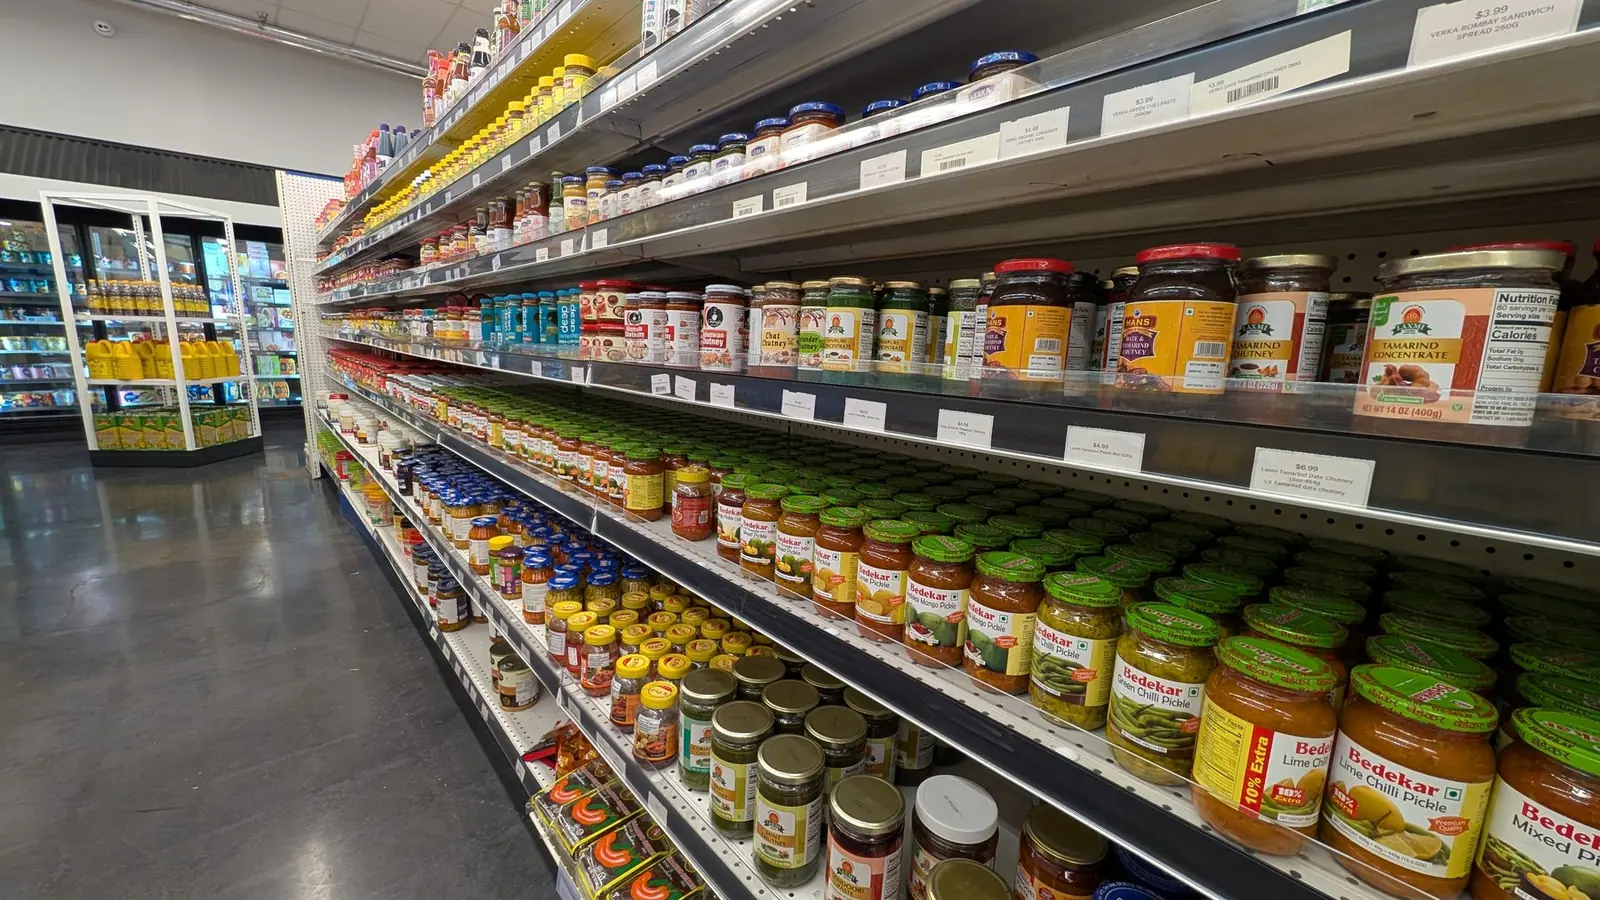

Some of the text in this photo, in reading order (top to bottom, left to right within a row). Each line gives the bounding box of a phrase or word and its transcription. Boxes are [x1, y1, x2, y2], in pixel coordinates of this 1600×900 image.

[1475, 5, 1509, 20] $3.99
[1430, 5, 1555, 38] VERKA BOMBAY SANDWICH
[1456, 21, 1520, 40] SPREAD 250G
[1224, 81, 1236, 89] DATE
[1237, 73, 1263, 84] TAMARIND
[1263, 65, 1287, 76] CHUTNEY
[1208, 79, 1225, 89] $3.99
[1112, 109, 1129, 117] VERKA
[1129, 104, 1145, 113] GREEN
[1160, 98, 1176, 107] PASTE
[1135, 96, 1154, 106] $3.99
[1499, 293, 1548, 304] Nutrition
[1509, 305, 1538, 313] servings
[1126, 318, 1150, 327] HANS
[1496, 312, 1527, 320] Serving
[765, 331, 780, 339] Chat
[1491, 330, 1537, 341] Calories
[1382, 342, 1439, 350] TAMARIND
[1373, 351, 1449, 360] CONCENTRATE
[1247, 381, 1256, 389] OZ
[1386, 406, 1396, 414] 14
[1398, 406, 1410, 415] OZ
[1411, 407, 1443, 419] (400g)
[1295, 463, 1319, 472] $6.99
[1279, 469, 1307, 478] Tamarind
[1308, 472, 1323, 480] Date
[1325, 475, 1354, 485] Chutney
[1274, 480, 1302, 489] Tamarind
[1318, 487, 1346, 496] chutney
[743, 520, 768, 530] Bedekar
[859, 564, 891, 582] Bedekar
[870, 579, 890, 589] Pickle
[910, 583, 947, 602] Bedekar
[920, 597, 939, 610] Mango
[939, 601, 956, 611] Pickle
[987, 622, 1006, 633] Pickle
[1040, 638, 1080, 660] Chilli Pickle
[1122, 665, 1184, 699] Bedekar
[1117, 673, 1191, 710] Green Chilli Pickle
[1295, 740, 1331, 756] Bede
[1283, 754, 1310, 769] Lime
[1246, 736, 1269, 805] 10% Extra
[1348, 746, 1441, 797] Bedekar
[1339, 756, 1448, 814] Lime Chilli Pickle
[1277, 786, 1302, 799] 10%
[1332, 785, 1354, 809] 10%
[1273, 794, 1302, 805] Extra
[1331, 797, 1353, 816] Extra
[1435, 819, 1466, 827] Premium
[1438, 825, 1463, 833] Quality
[766, 830, 782, 840] MINT
[1512, 813, 1571, 856] Mixed
